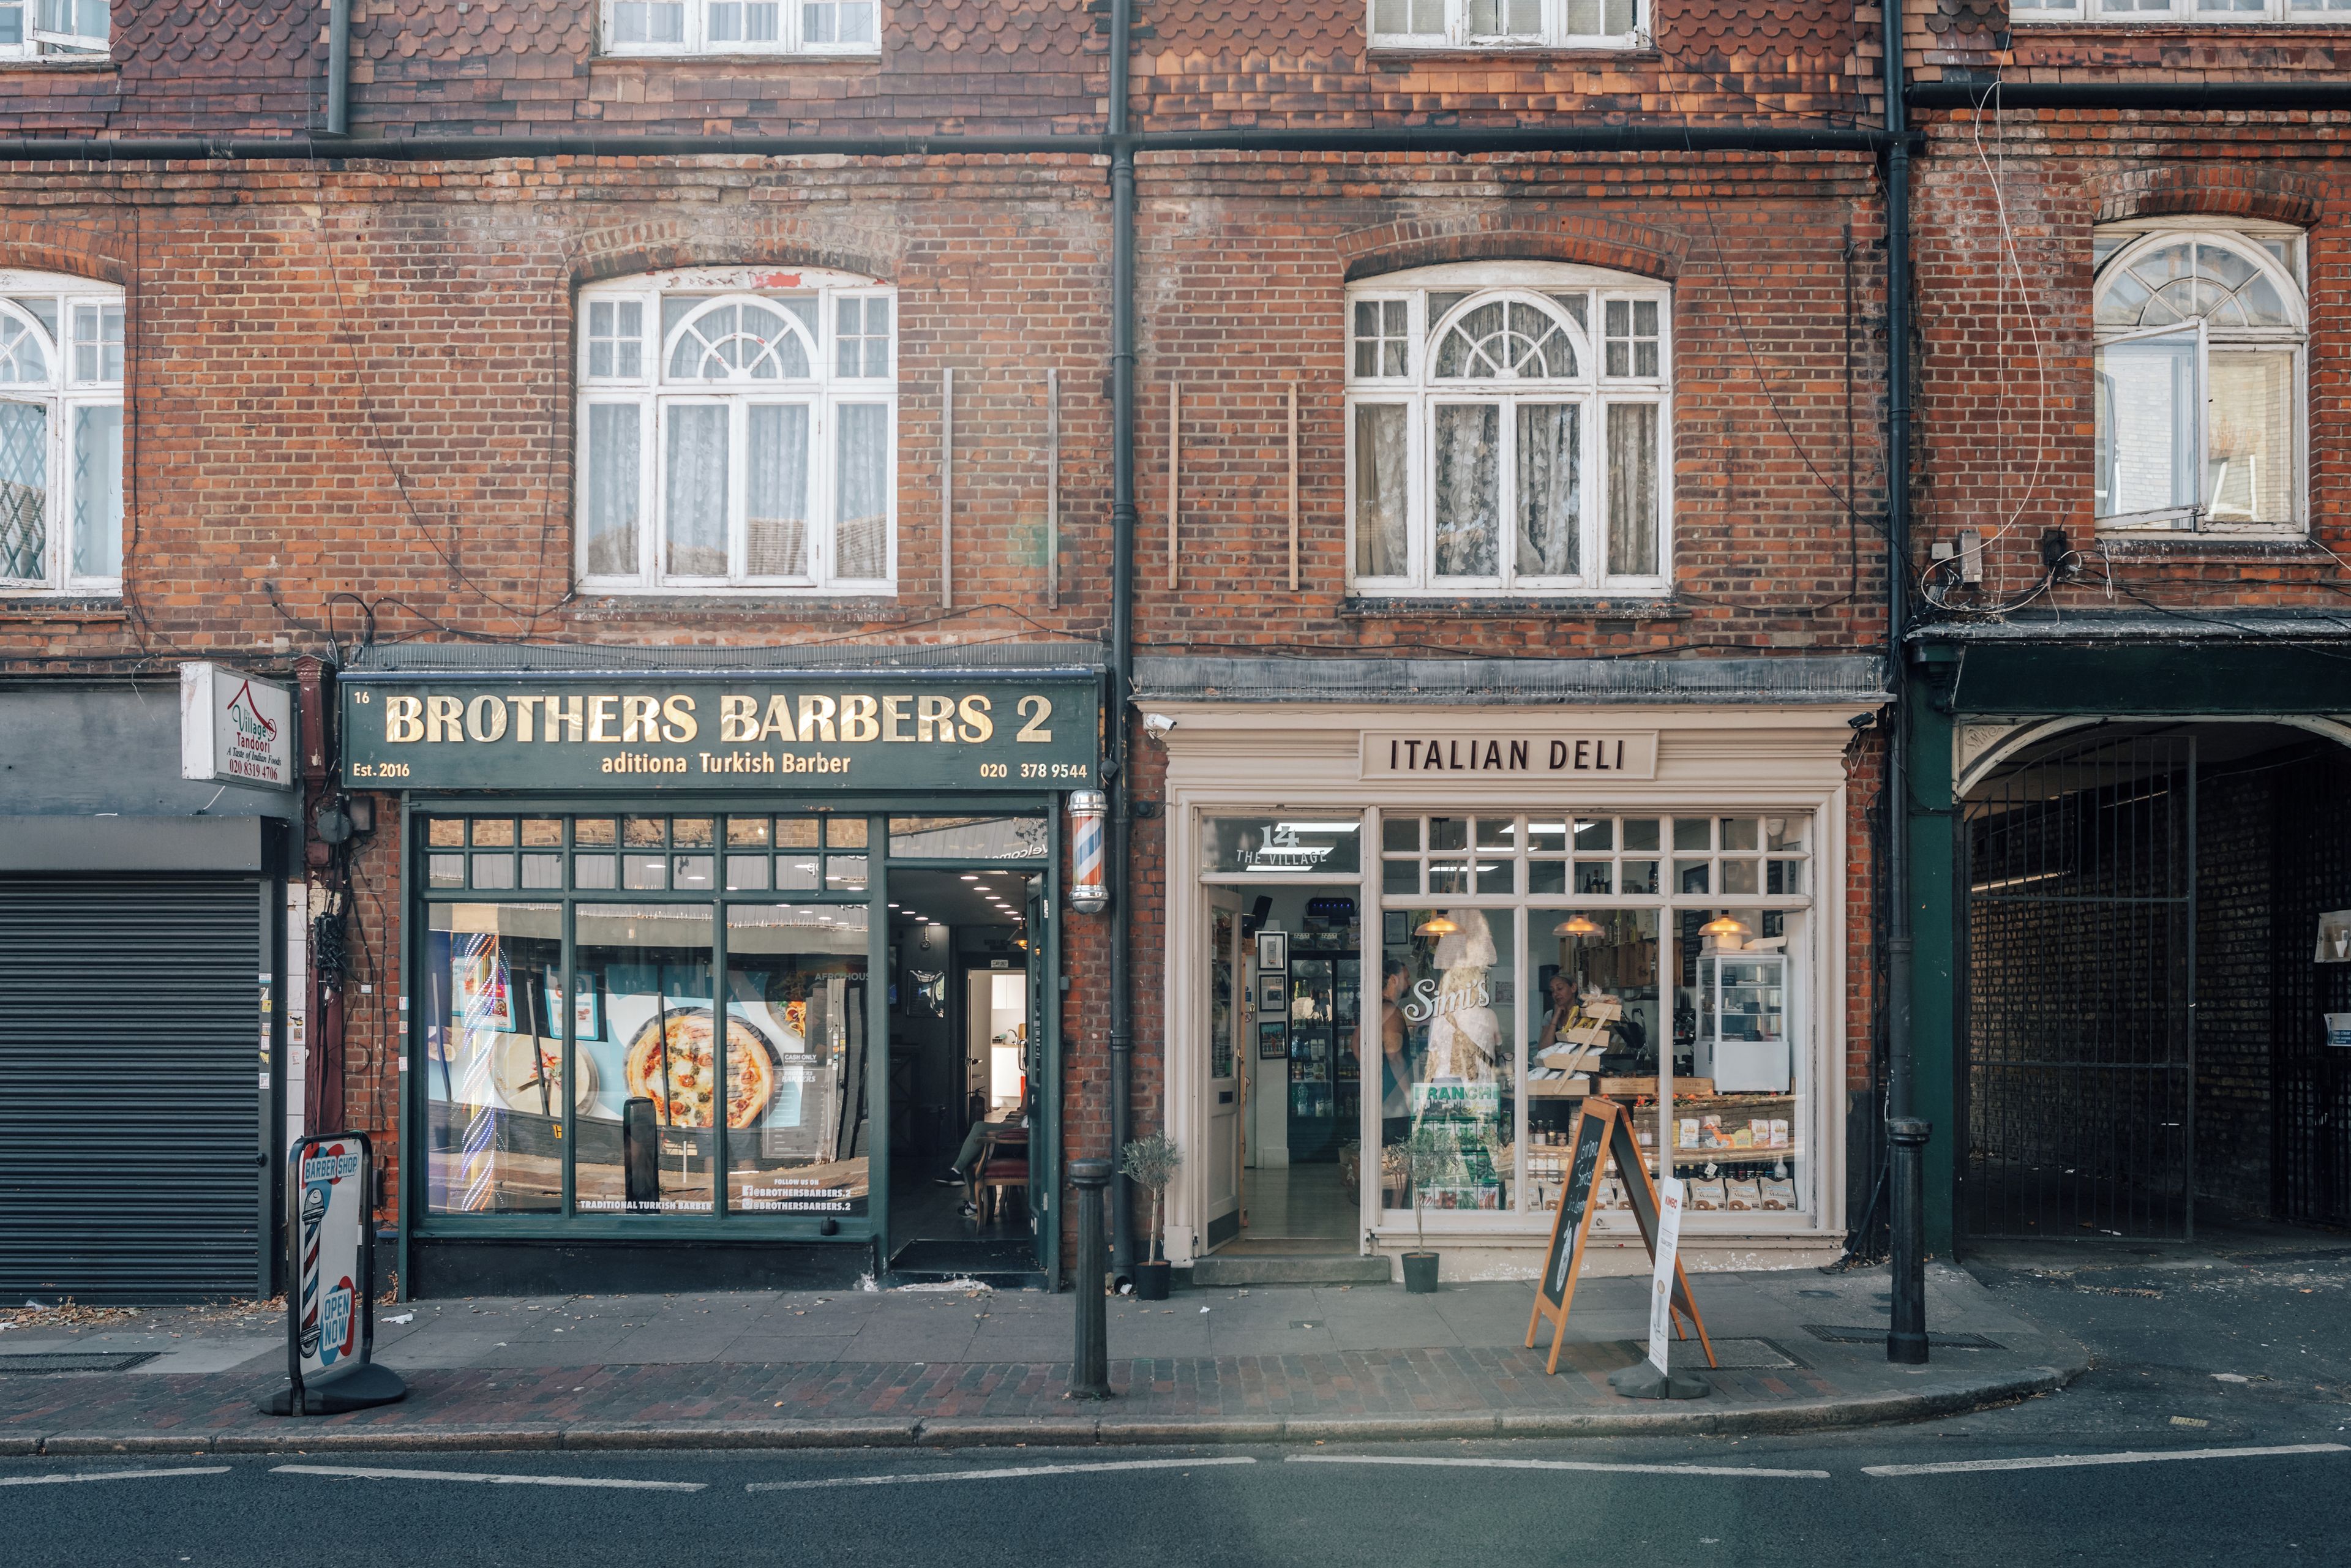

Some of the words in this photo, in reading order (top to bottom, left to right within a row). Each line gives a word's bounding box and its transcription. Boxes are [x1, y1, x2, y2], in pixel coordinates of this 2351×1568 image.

[354, 691, 369, 703] 16
[232, 704, 266, 740] Village
[386, 695, 698, 743] BROTHERS
[720, 694, 993, 743] BARBERS
[1016, 695, 1052, 743] 2
[237, 732, 270, 753] Tandoori
[227, 747, 231, 756] A
[233, 747, 244, 758] Taste
[246, 751, 251, 762] of
[252, 751, 266, 763] Indian
[268, 755, 282, 766] Foods
[602, 753, 687, 773] aditiona
[699, 752, 774, 773] Turkish
[782, 752, 851, 773] Barber
[1390, 740, 1528, 770] ITALIAN
[1549, 740, 1624, 770] DELI
[230, 759, 242, 774] 020
[244, 762, 260, 778] 8319
[262, 765, 278, 780] 4706
[353, 763, 377, 778] Est.
[379, 763, 410, 778] 2016
[980, 763, 1007, 778] 020
[1021, 763, 1047, 778] 378
[1051, 763, 1087, 779] 9544
[1260, 825, 1299, 847] 14
[1236, 849, 1261, 865] THE
[1269, 850, 1327, 865] VILLAGE
[1404, 978, 1491, 1022] Simi's
[1414, 1086, 1498, 1100] FRANCHI
[306, 1159, 336, 1179] BARBER
[338, 1155, 357, 1175] SHOP
[754, 1188, 851, 1197] @BROTHERSBARBERS.2
[580, 1201, 637, 1209] TRADITIONAL
[754, 1201, 851, 1210] @BROTHERSBARBERS.2
[324, 1293, 350, 1321] OPEN
[326, 1318, 347, 1346] NOW
